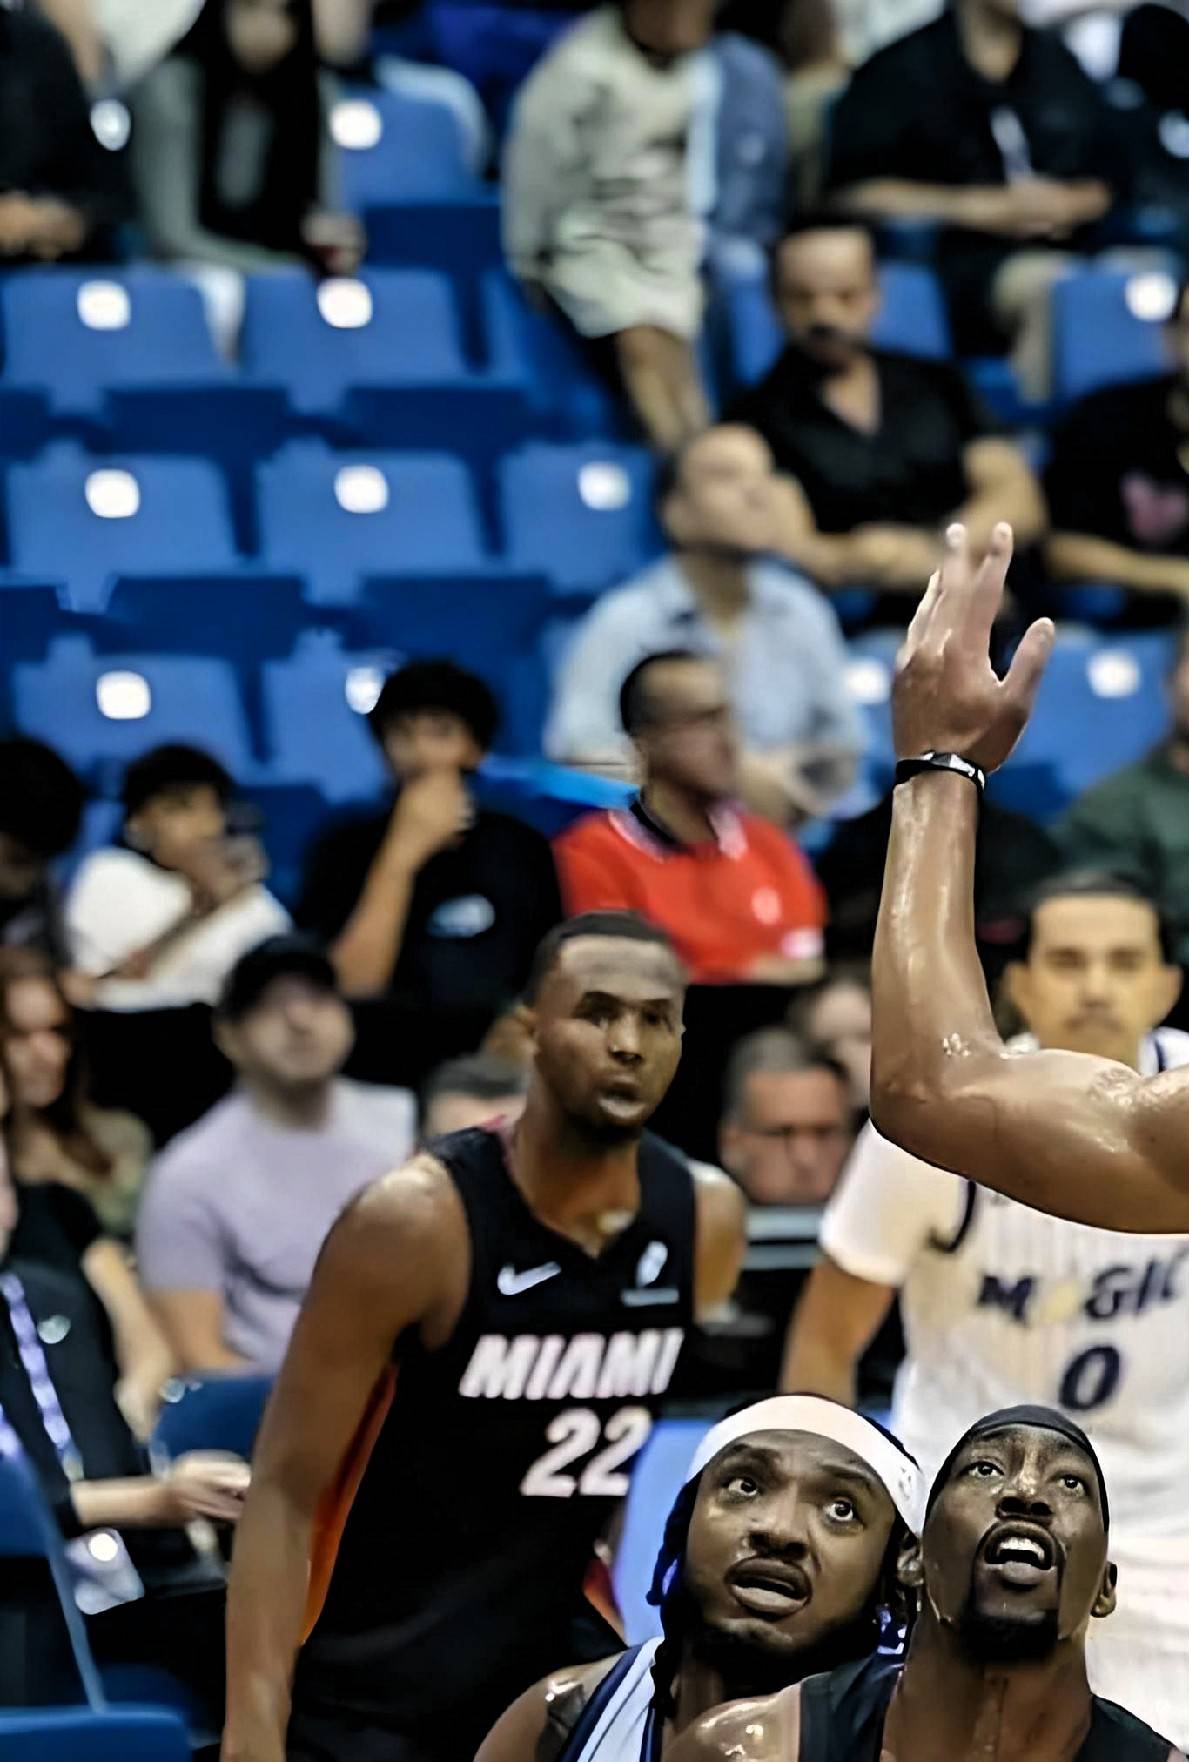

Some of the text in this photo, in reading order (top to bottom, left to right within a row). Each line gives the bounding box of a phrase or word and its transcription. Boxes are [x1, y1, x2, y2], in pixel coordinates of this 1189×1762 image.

[458, 1327, 685, 1401] MIAMI
[1056, 1343, 1122, 1412] 0
[519, 1404, 653, 1498] 22
